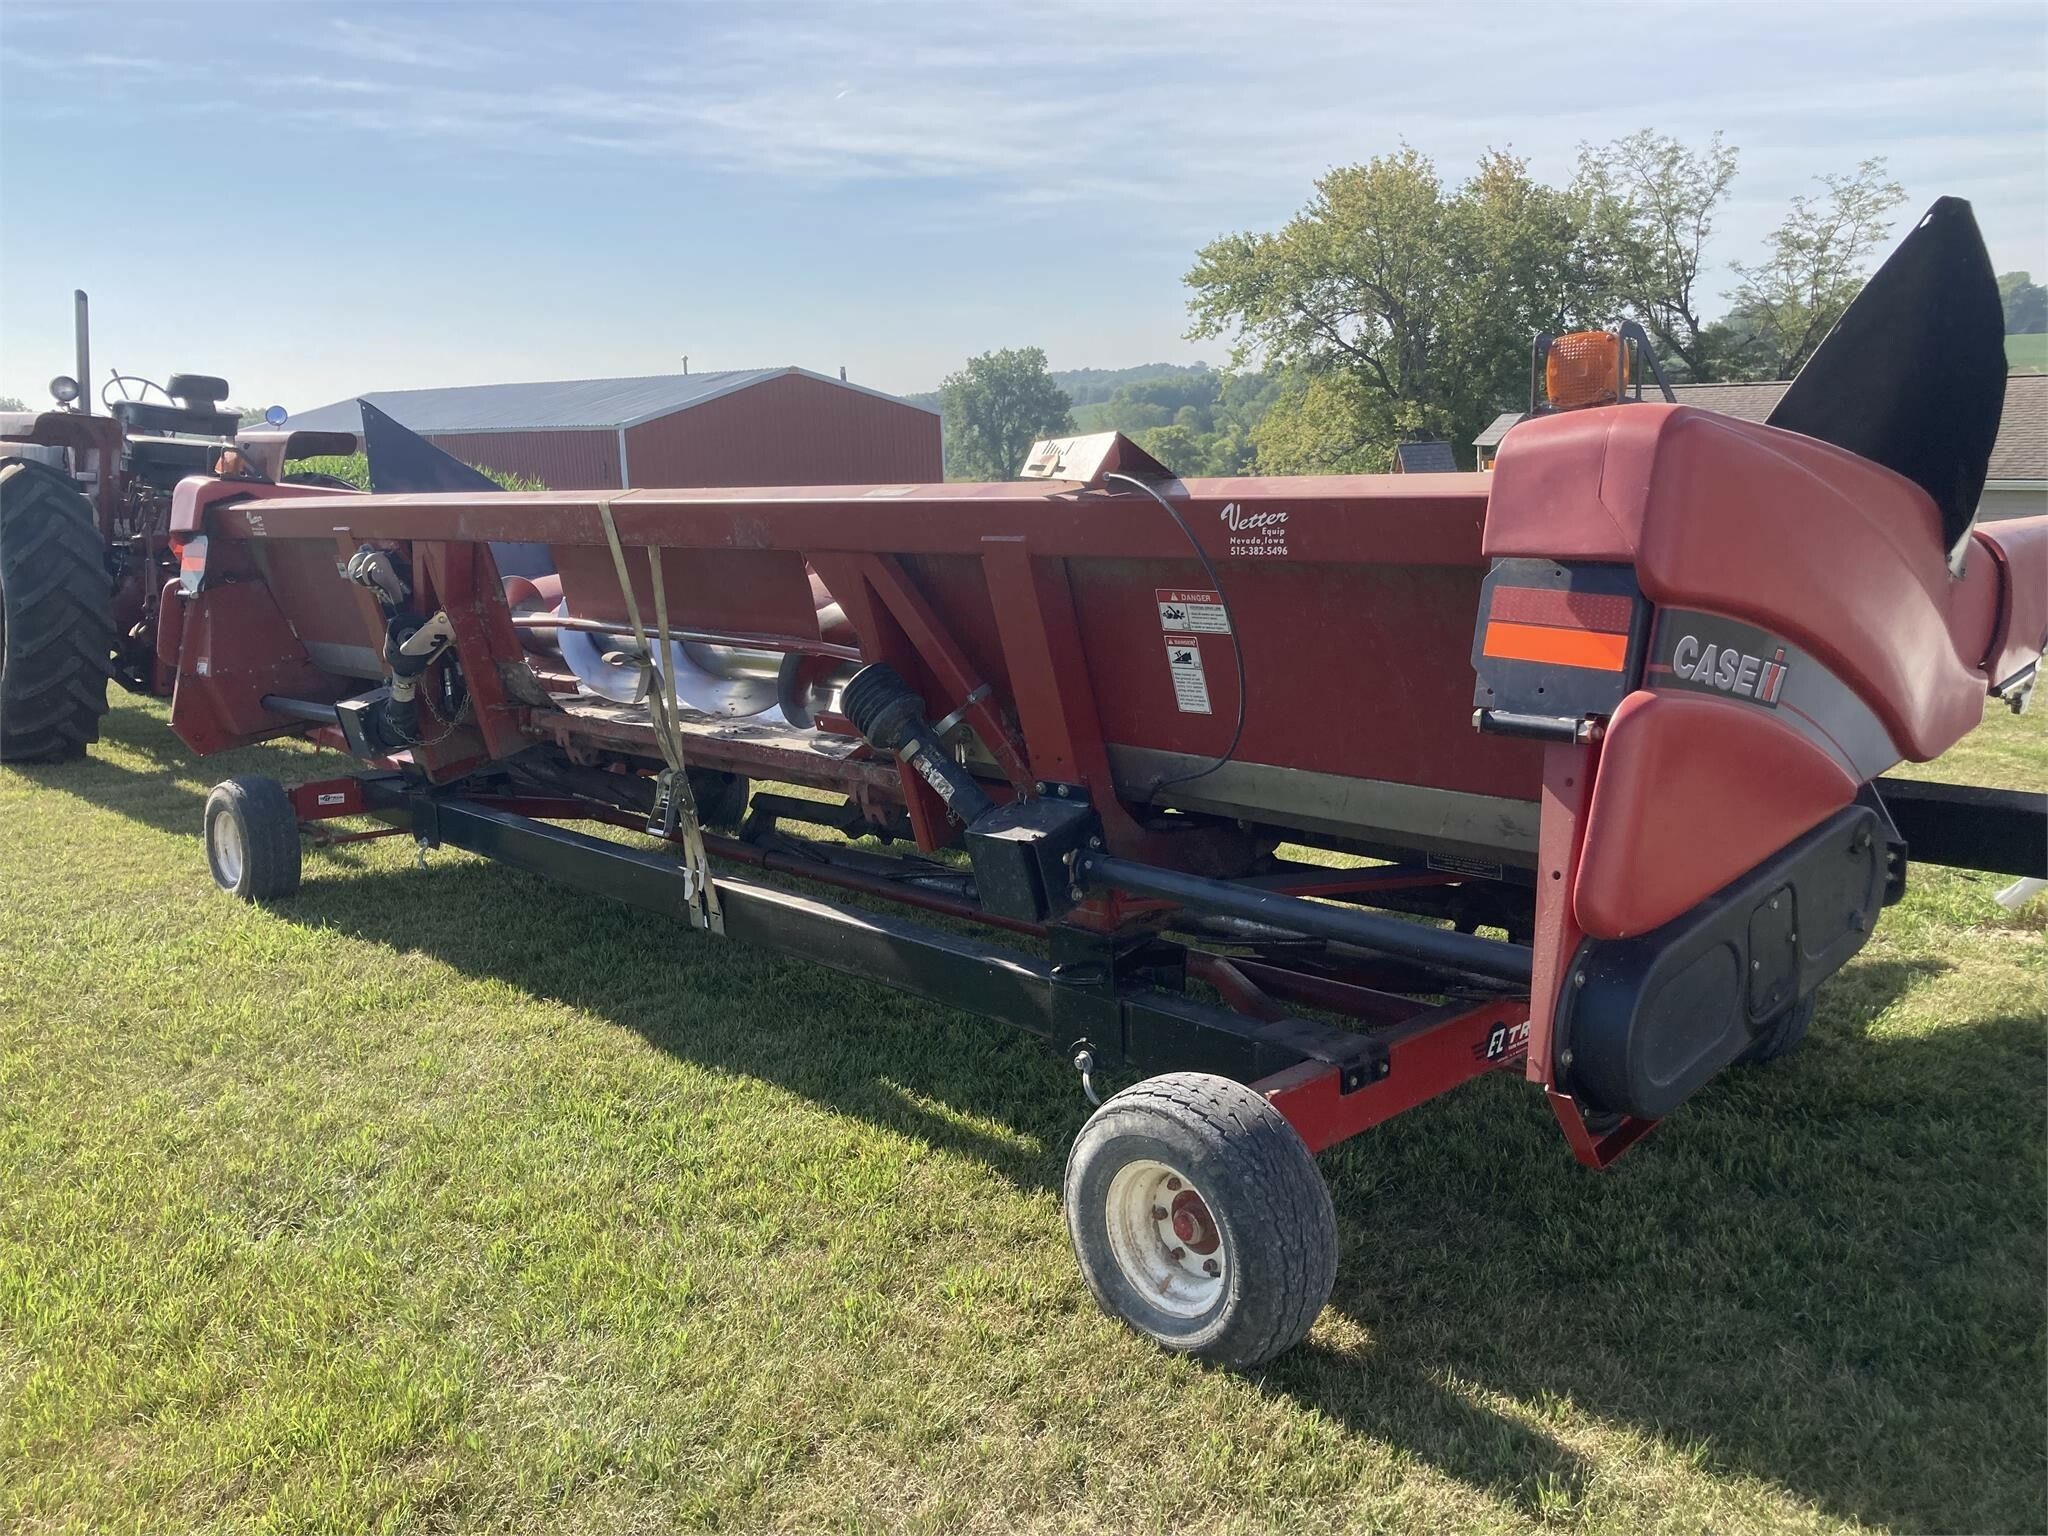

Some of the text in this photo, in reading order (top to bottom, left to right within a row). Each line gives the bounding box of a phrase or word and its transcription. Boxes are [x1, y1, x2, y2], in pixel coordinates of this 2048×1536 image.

[1220, 502, 1289, 531] Vetter
[1261, 527, 1285, 537] Equip
[1230, 546, 1288, 556] 515-382-5496
[1181, 594, 1211, 602] DANGER
